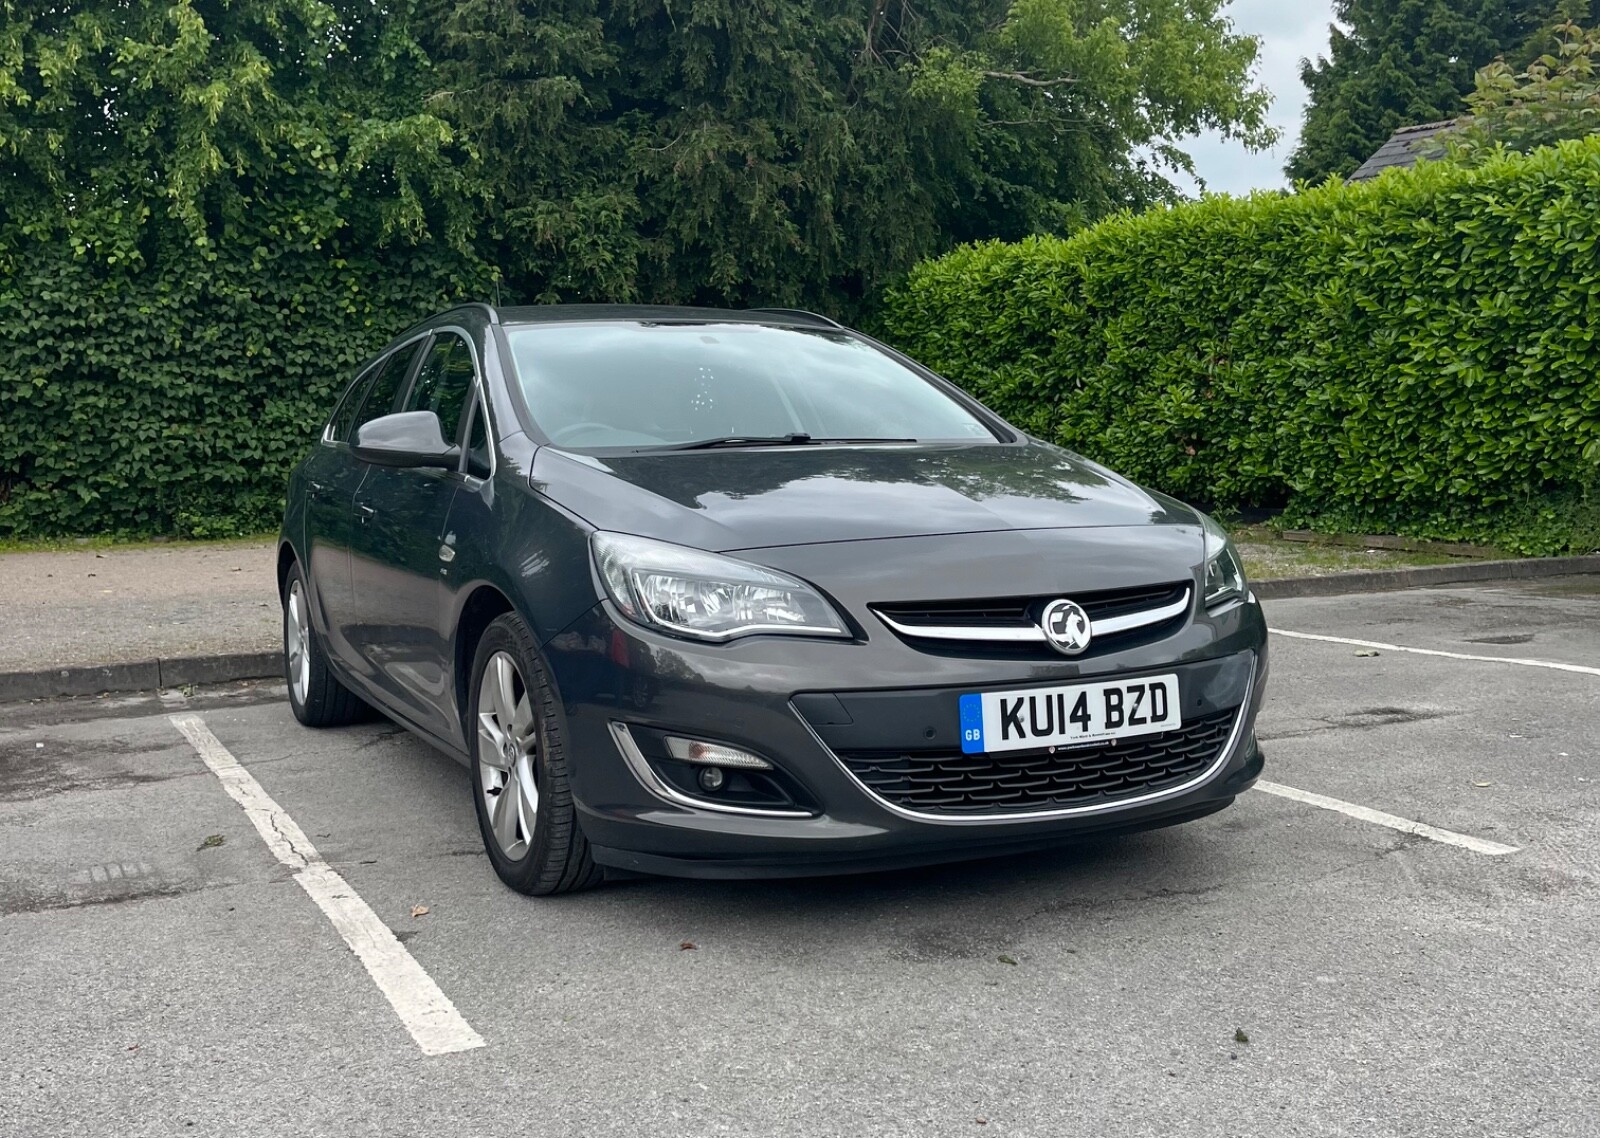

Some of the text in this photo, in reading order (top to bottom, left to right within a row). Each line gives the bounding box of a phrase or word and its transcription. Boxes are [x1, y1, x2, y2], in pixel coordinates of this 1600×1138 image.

[1000, 682, 1168, 741] KU14 BZD
[965, 729, 980, 741] GB
